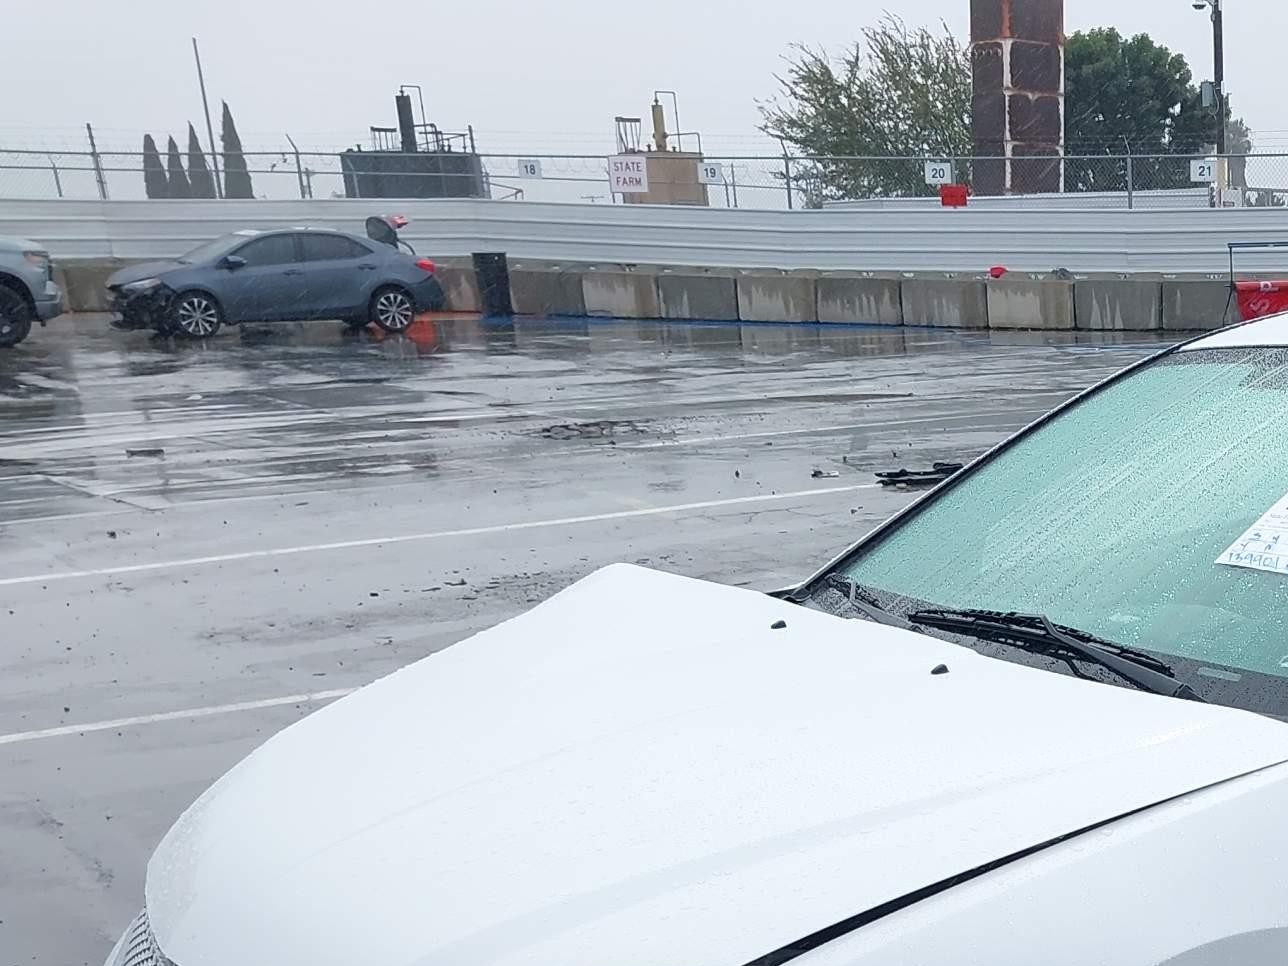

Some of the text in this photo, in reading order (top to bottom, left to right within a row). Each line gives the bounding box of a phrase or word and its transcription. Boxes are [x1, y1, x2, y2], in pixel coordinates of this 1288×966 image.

[524, 164, 536, 175] 18
[614, 161, 642, 172] STATE
[1198, 165, 1211, 177] 21
[703, 167, 716, 178] 19
[931, 168, 945, 179] 20
[616, 176, 642, 187] FARM
